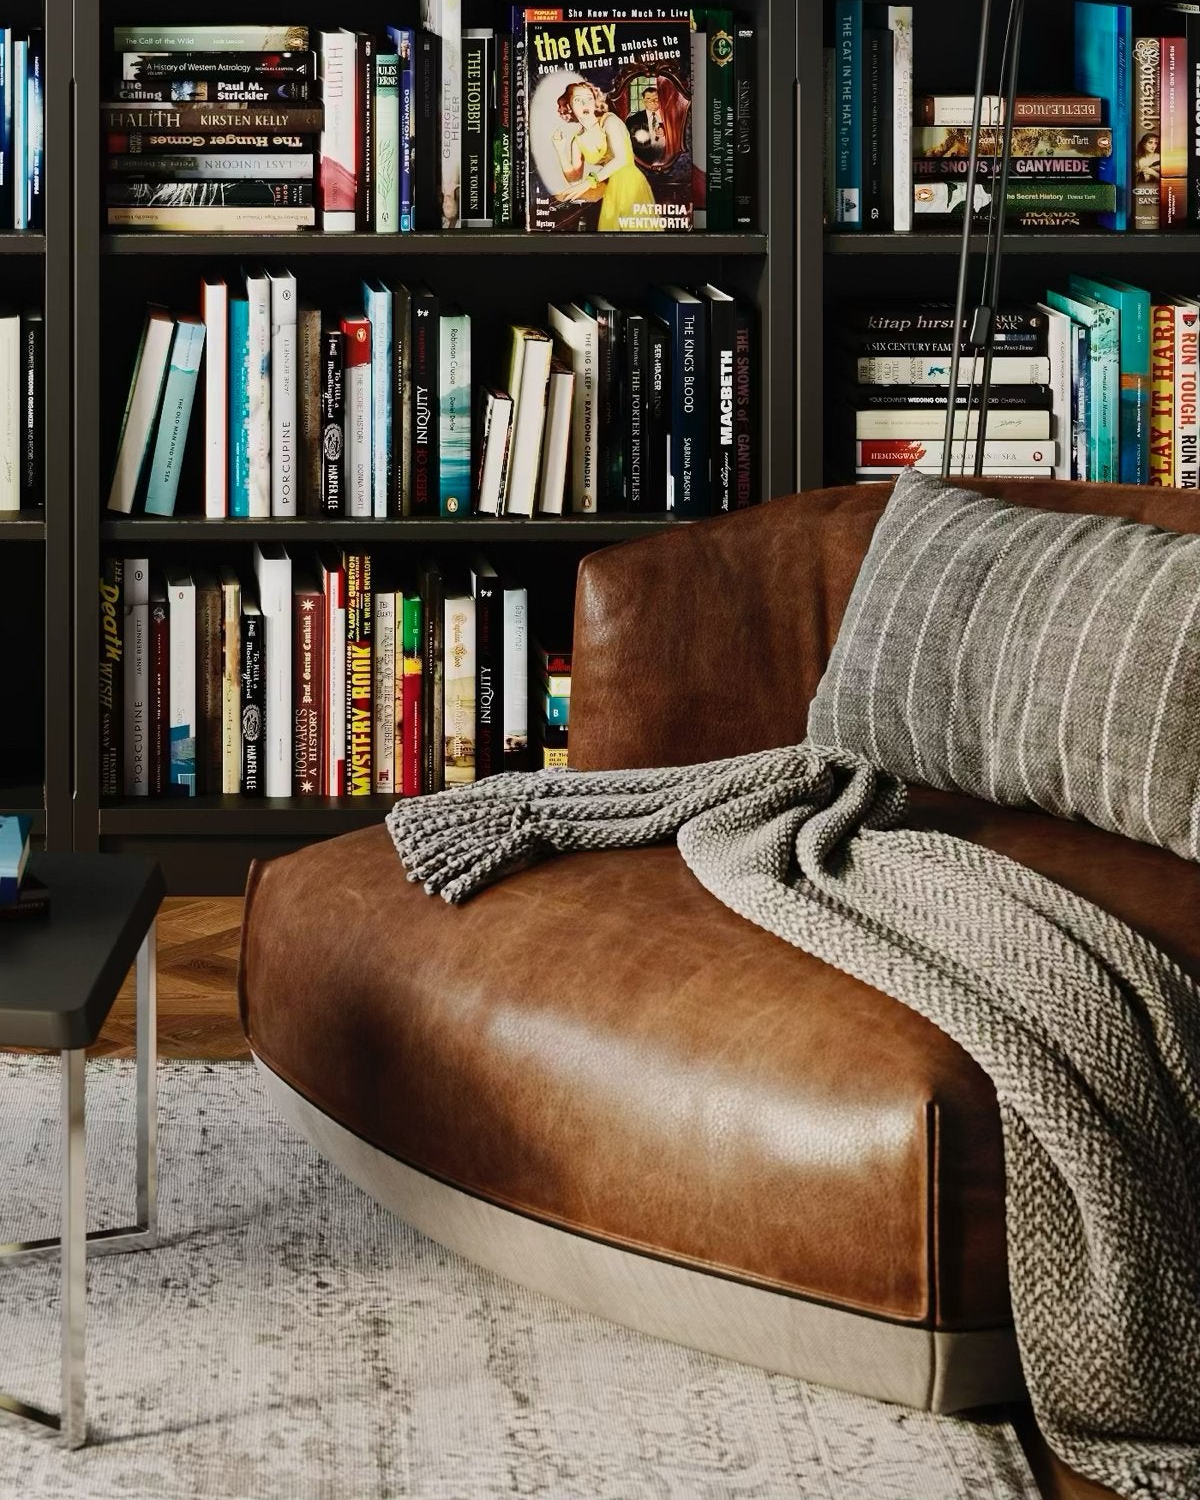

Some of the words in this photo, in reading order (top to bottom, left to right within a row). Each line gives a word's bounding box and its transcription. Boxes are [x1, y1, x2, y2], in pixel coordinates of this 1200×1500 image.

[842, 16, 852, 37] THE
[534, 32, 571, 62] the
[575, 24, 616, 57] KEY
[621, 37, 658, 51] unlocks
[663, 35, 679, 46] the
[842, 40, 851, 61] CAT
[328, 46, 343, 98] LILITH
[467, 50, 481, 78] THE
[538, 64, 559, 75] door
[565, 62, 574, 72] to
[580, 59, 613, 70] murder
[618, 55, 635, 65] and
[641, 50, 681, 62] violence
[842, 65, 851, 77] IN
[120, 90, 163, 101] Calling
[217, 91, 268, 101] Strickler
[842, 80, 851, 101] THE
[110, 110, 180, 127] HALITH
[200, 114, 251, 126] KIRSTEN
[255, 114, 290, 126] KELLY
[467, 82, 481, 133] HOBBIT
[842, 104, 851, 125] HAT
[1017, 104, 1096, 115] BEETLEJUICE
[150, 134, 207, 146] Games
[210, 134, 268, 148] Hunger
[273, 134, 302, 147] The
[1057, 136, 1073, 145] Donna
[1073, 135, 1089, 145] Tartt
[469, 155, 479, 174] J.R.R.
[470, 175, 479, 210] TOLKIEN
[632, 203, 687, 215] PATRICIA
[685, 315, 694, 335] THE
[867, 316, 911, 331] kitap
[450, 328, 458, 360] Robinson
[684, 339, 694, 372] KING'S
[1152, 306, 1174, 382] HARD
[1181, 333, 1197, 368] RUN
[450, 362, 458, 385] Crusoe
[632, 369, 640, 392] THE
[684, 376, 694, 413] BLOOD
[721, 351, 733, 445] MACBETH
[1152, 390, 1172, 417] IT
[1179, 372, 1197, 430] TOUGH,
[632, 394, 640, 436] PORTER
[282, 421, 290, 504] PORCUPINE
[1181, 435, 1197, 464] RUN
[328, 464, 339, 494] HARPER
[631, 439, 640, 501] PRINCIPLES
[683, 471, 691, 501] ZBASNIK
[328, 496, 338, 510] LEE
[100, 662, 112, 709] WISH
[351, 644, 370, 699] BOOK
[480, 665, 494, 724] INIQUITY
[134, 700, 143, 783] PORCUPINE
[295, 709, 307, 777] HOGWARTS
[309, 709, 317, 762] HISTORY
[246, 744, 256, 774] HARPER
[352, 707, 370, 795] MYSTERY
[246, 776, 256, 790] LEE
[309, 767, 317, 776] A
